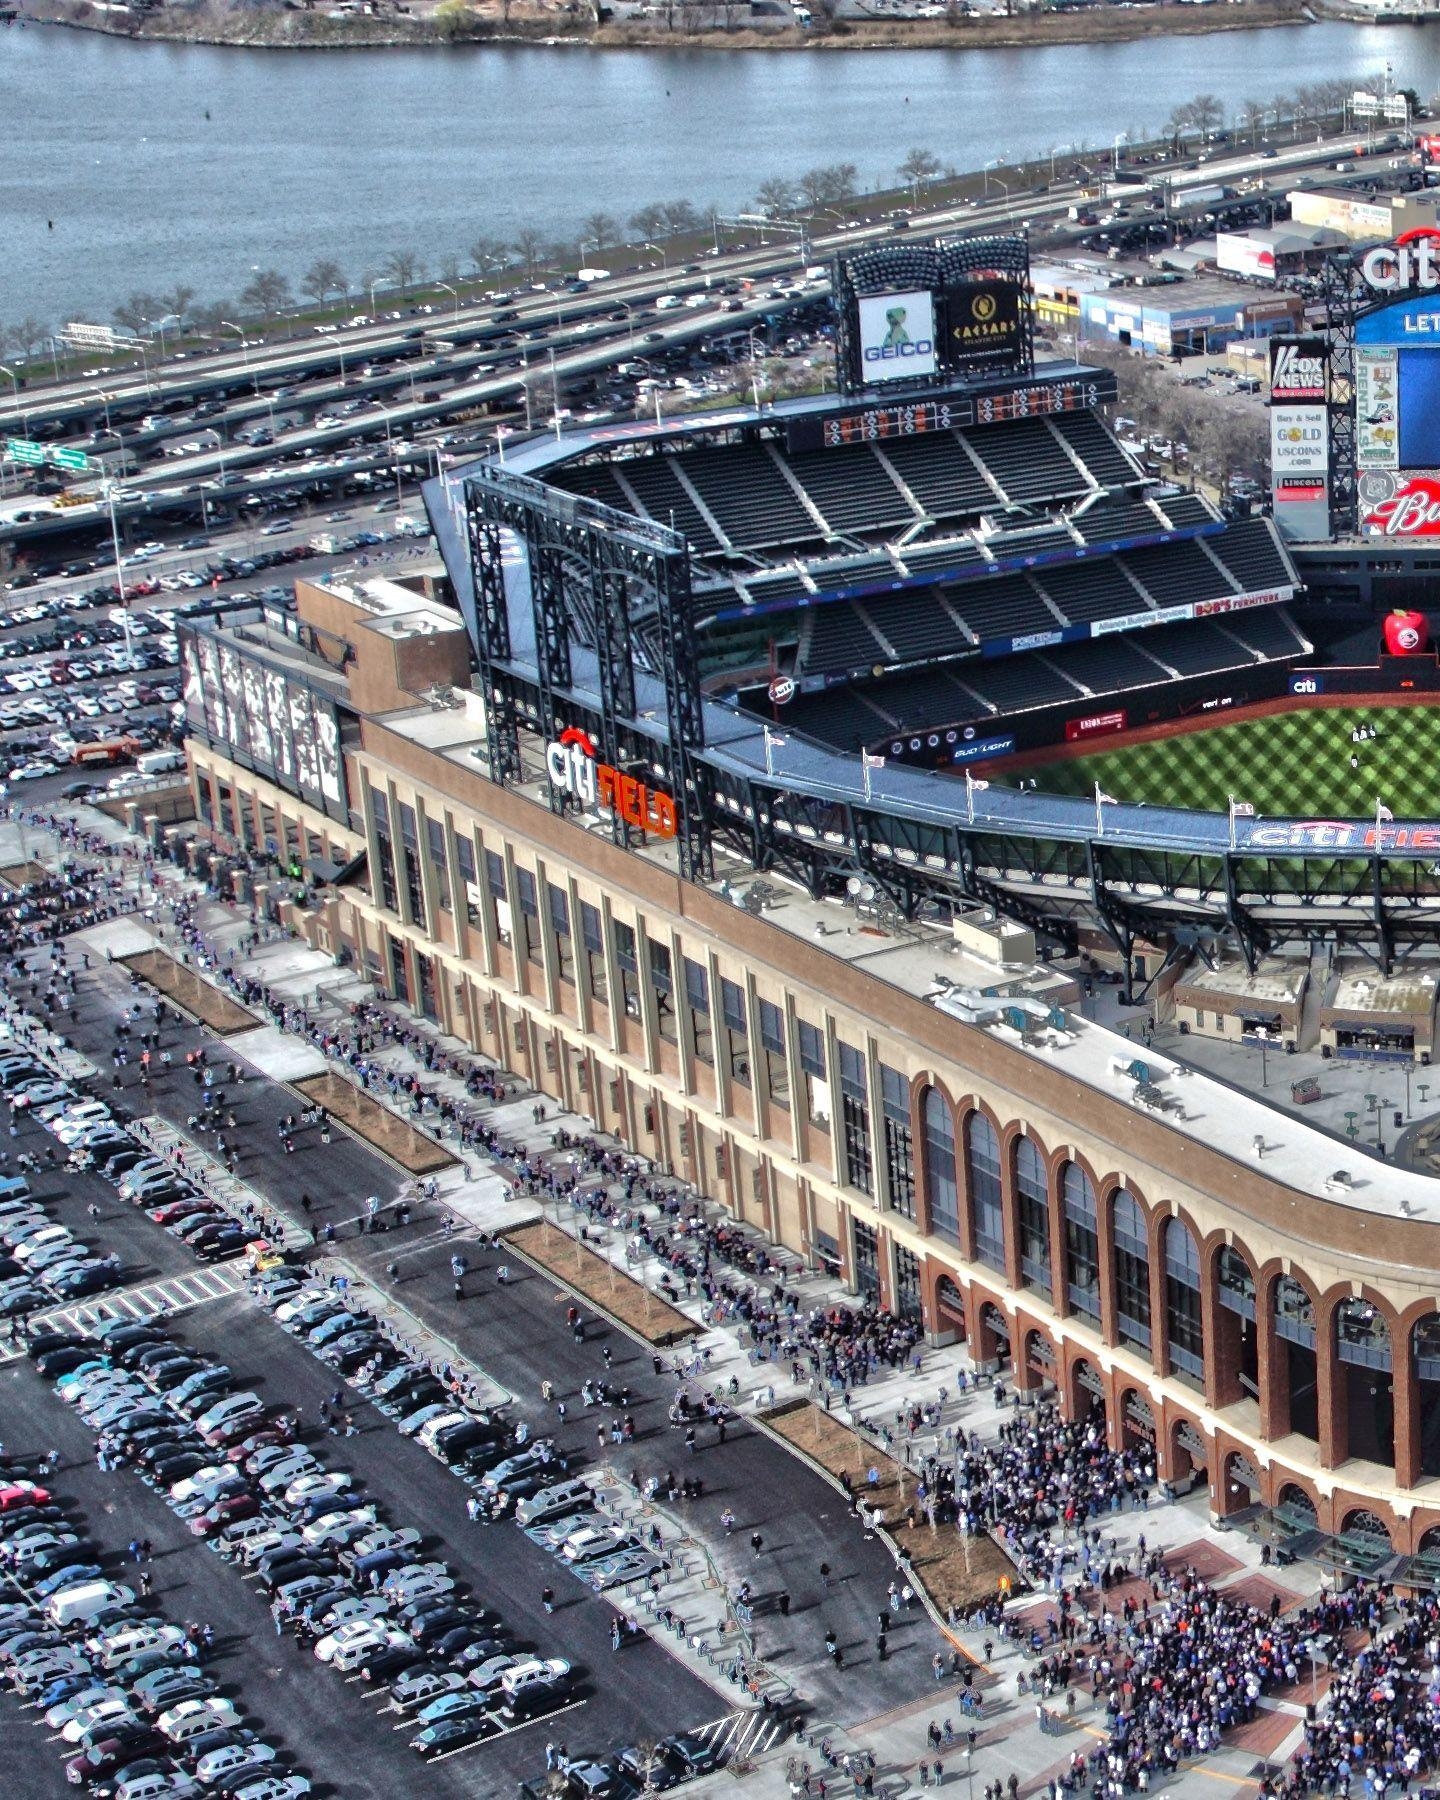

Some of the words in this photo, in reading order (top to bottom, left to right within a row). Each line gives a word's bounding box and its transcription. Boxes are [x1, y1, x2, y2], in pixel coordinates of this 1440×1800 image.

[953, 320, 1016, 339] CAESARS
[865, 340, 933, 362] GEICO
[1288, 357, 1322, 373] FOX
[1280, 373, 1324, 388] NEWS
[1358, 365, 1369, 447] RENTALS
[1284, 478, 1323, 488] LINCOLN
[597, 764, 676, 840] FIELD
[1250, 824, 1352, 846] citi
